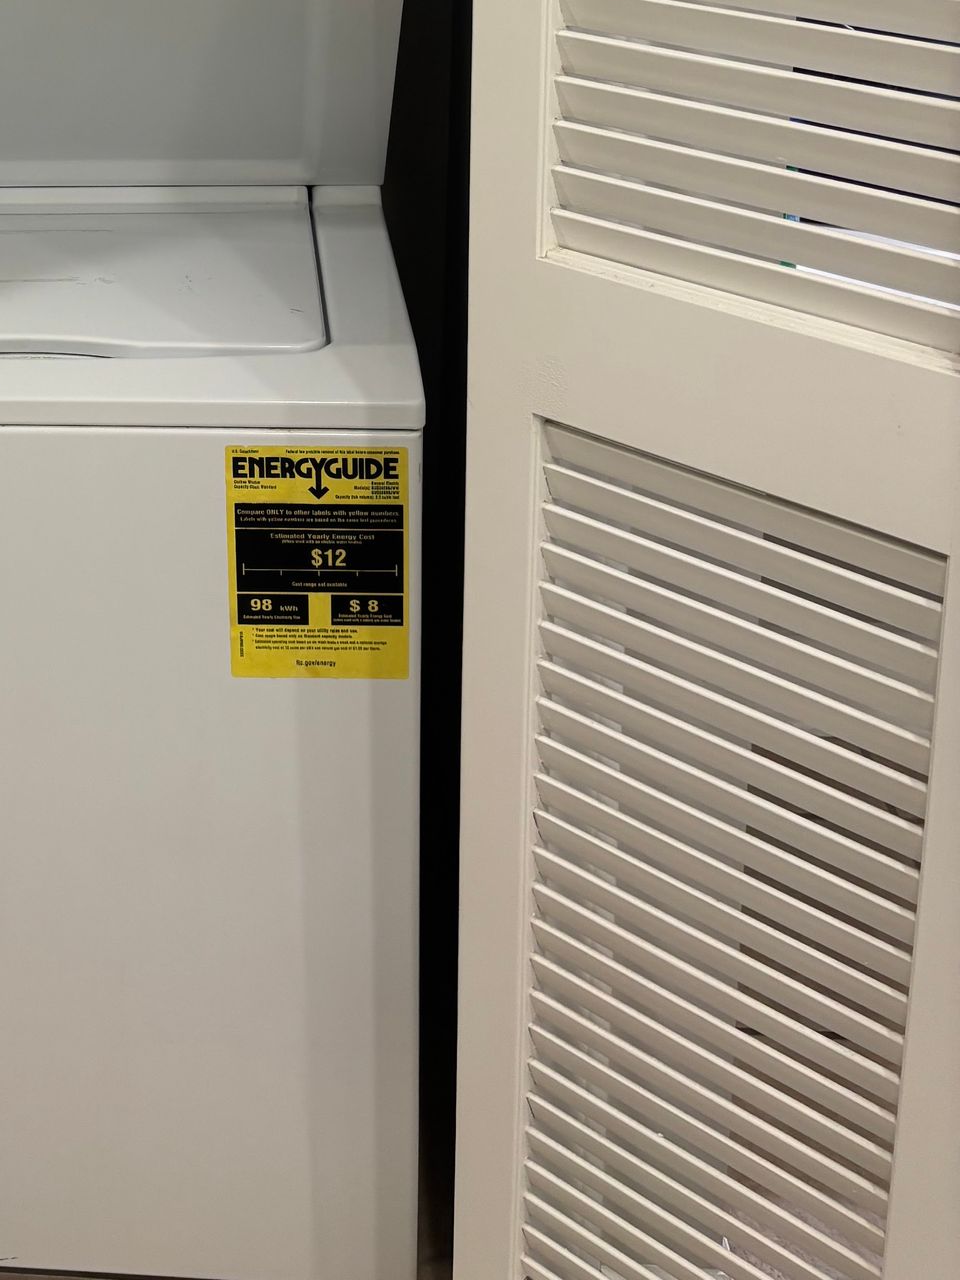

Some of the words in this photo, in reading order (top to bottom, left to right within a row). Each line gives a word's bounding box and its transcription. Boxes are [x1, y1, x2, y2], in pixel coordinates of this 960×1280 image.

[232, 456, 400, 480] ENERGYGUIDE
[311, 548, 347, 568] $12
[251, 599, 272, 611] 98
[350, 600, 360, 613] $
[368, 600, 379, 612] 8
